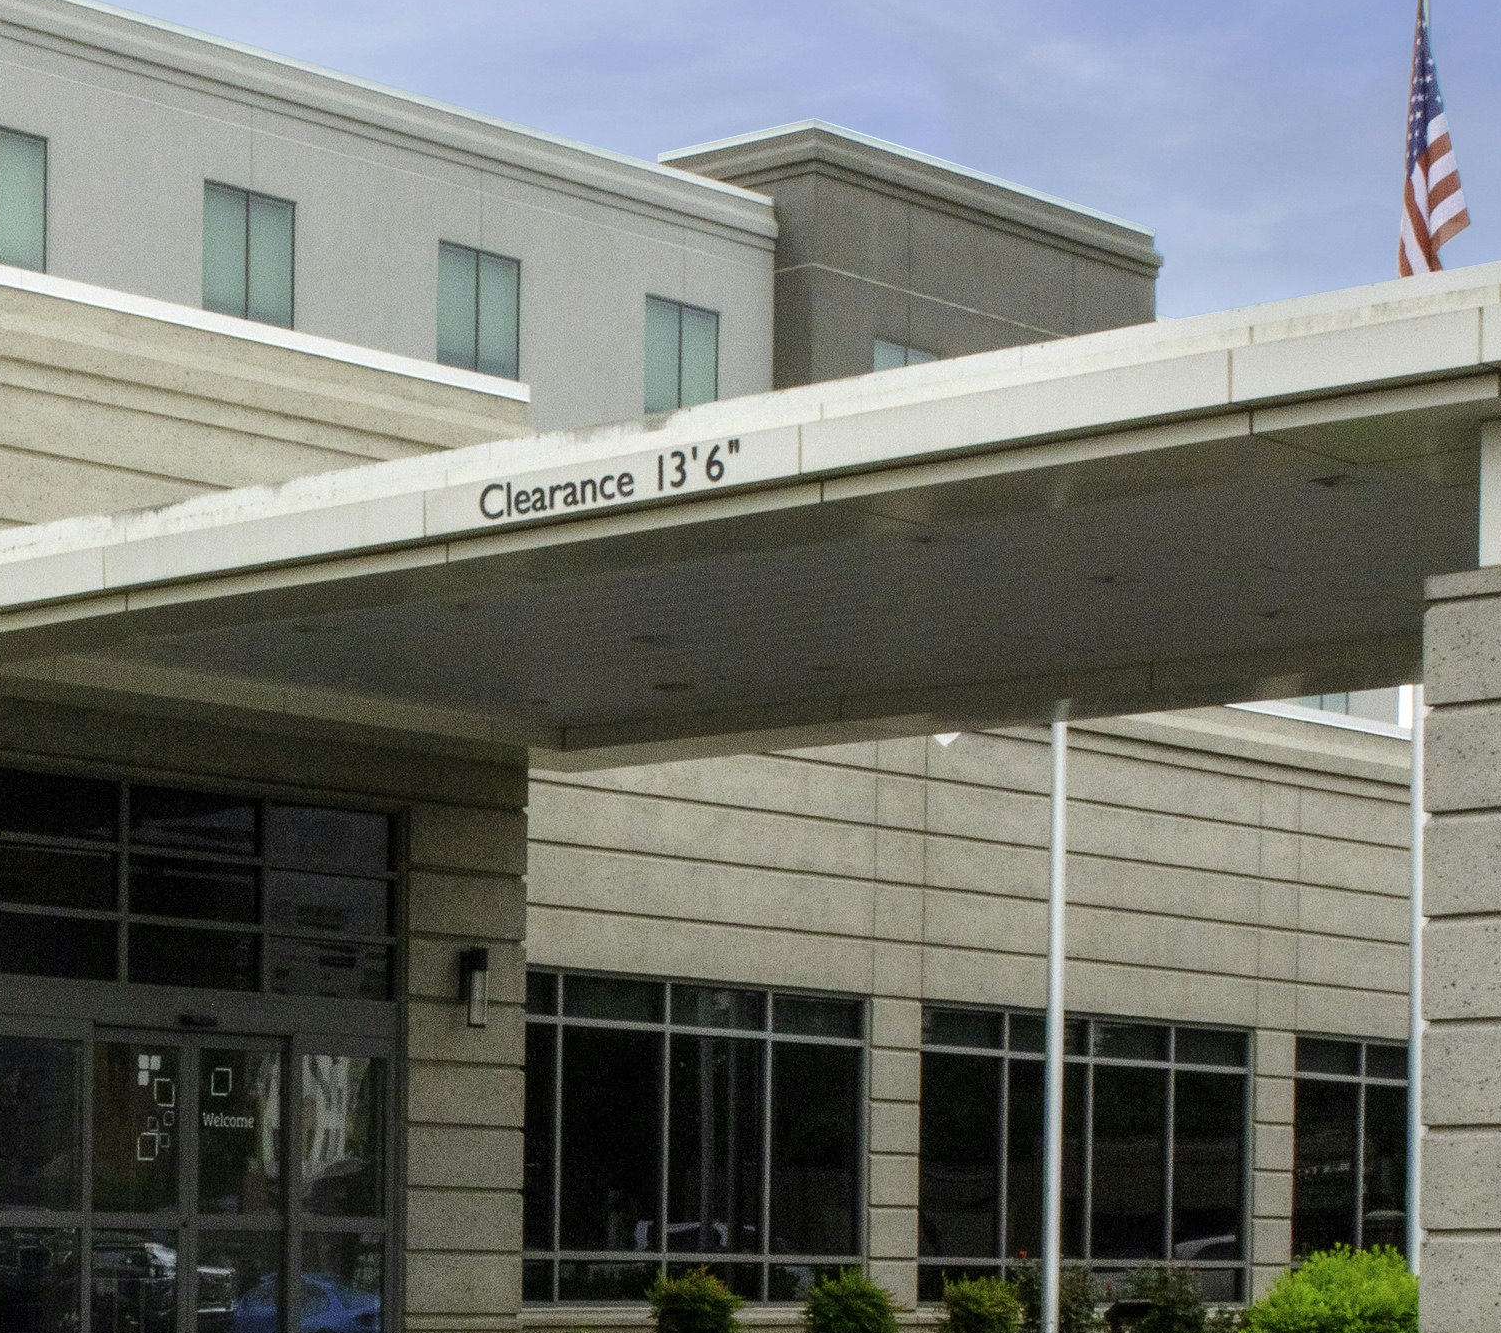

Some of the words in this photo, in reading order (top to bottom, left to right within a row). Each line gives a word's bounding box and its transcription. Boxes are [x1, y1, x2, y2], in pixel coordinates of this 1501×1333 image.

[480, 472, 635, 519] Clearance
[657, 439, 740, 491] 13'6"
[202, 1111, 255, 1129] Welcome
